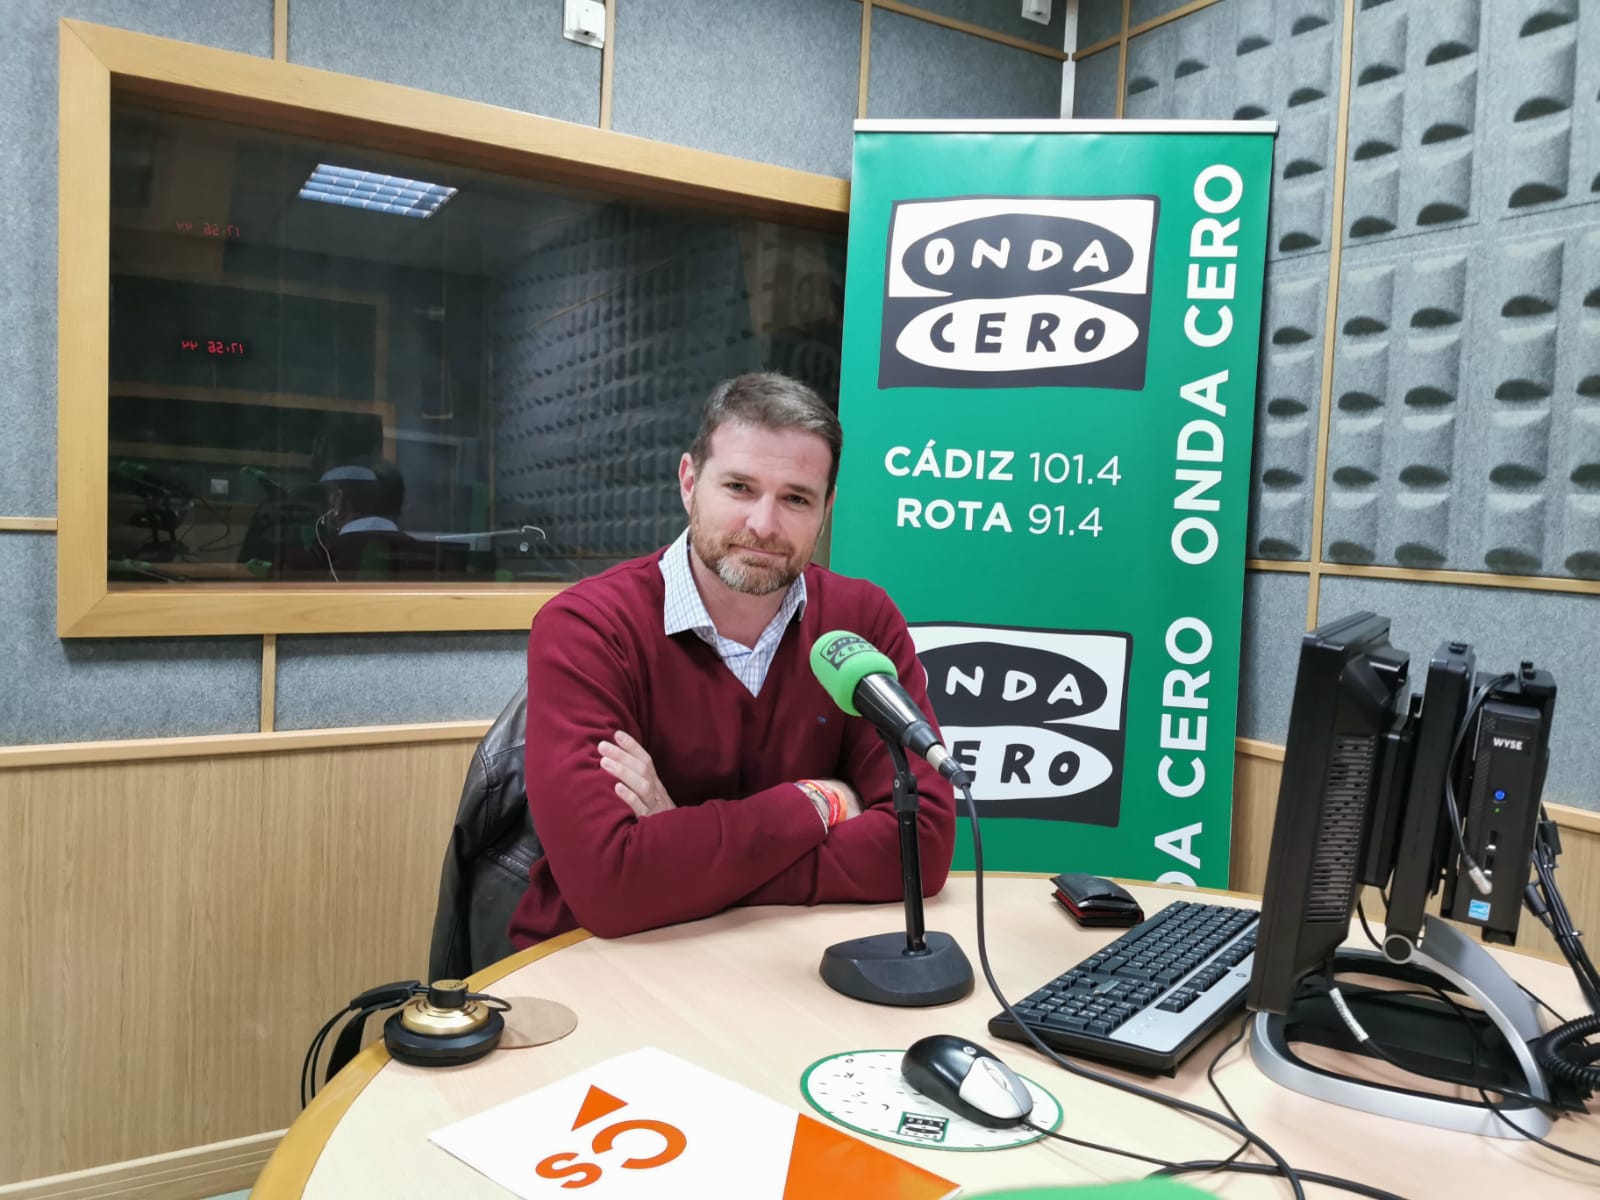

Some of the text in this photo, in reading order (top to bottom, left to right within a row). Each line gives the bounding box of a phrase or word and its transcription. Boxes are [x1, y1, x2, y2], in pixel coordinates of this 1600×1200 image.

[923, 237, 1110, 275] ONDA
[929, 312, 1106, 354] CERO
[884, 439, 1122, 486] CÁDIZ 101.4
[896, 498, 1103, 538] ROTA 91.4
[1154, 163, 1243, 887] A CERO ONDA CERO
[922, 665, 1083, 706] NDA
[951, 740, 1080, 786] ERO
[1493, 737, 1523, 750] WYSE
